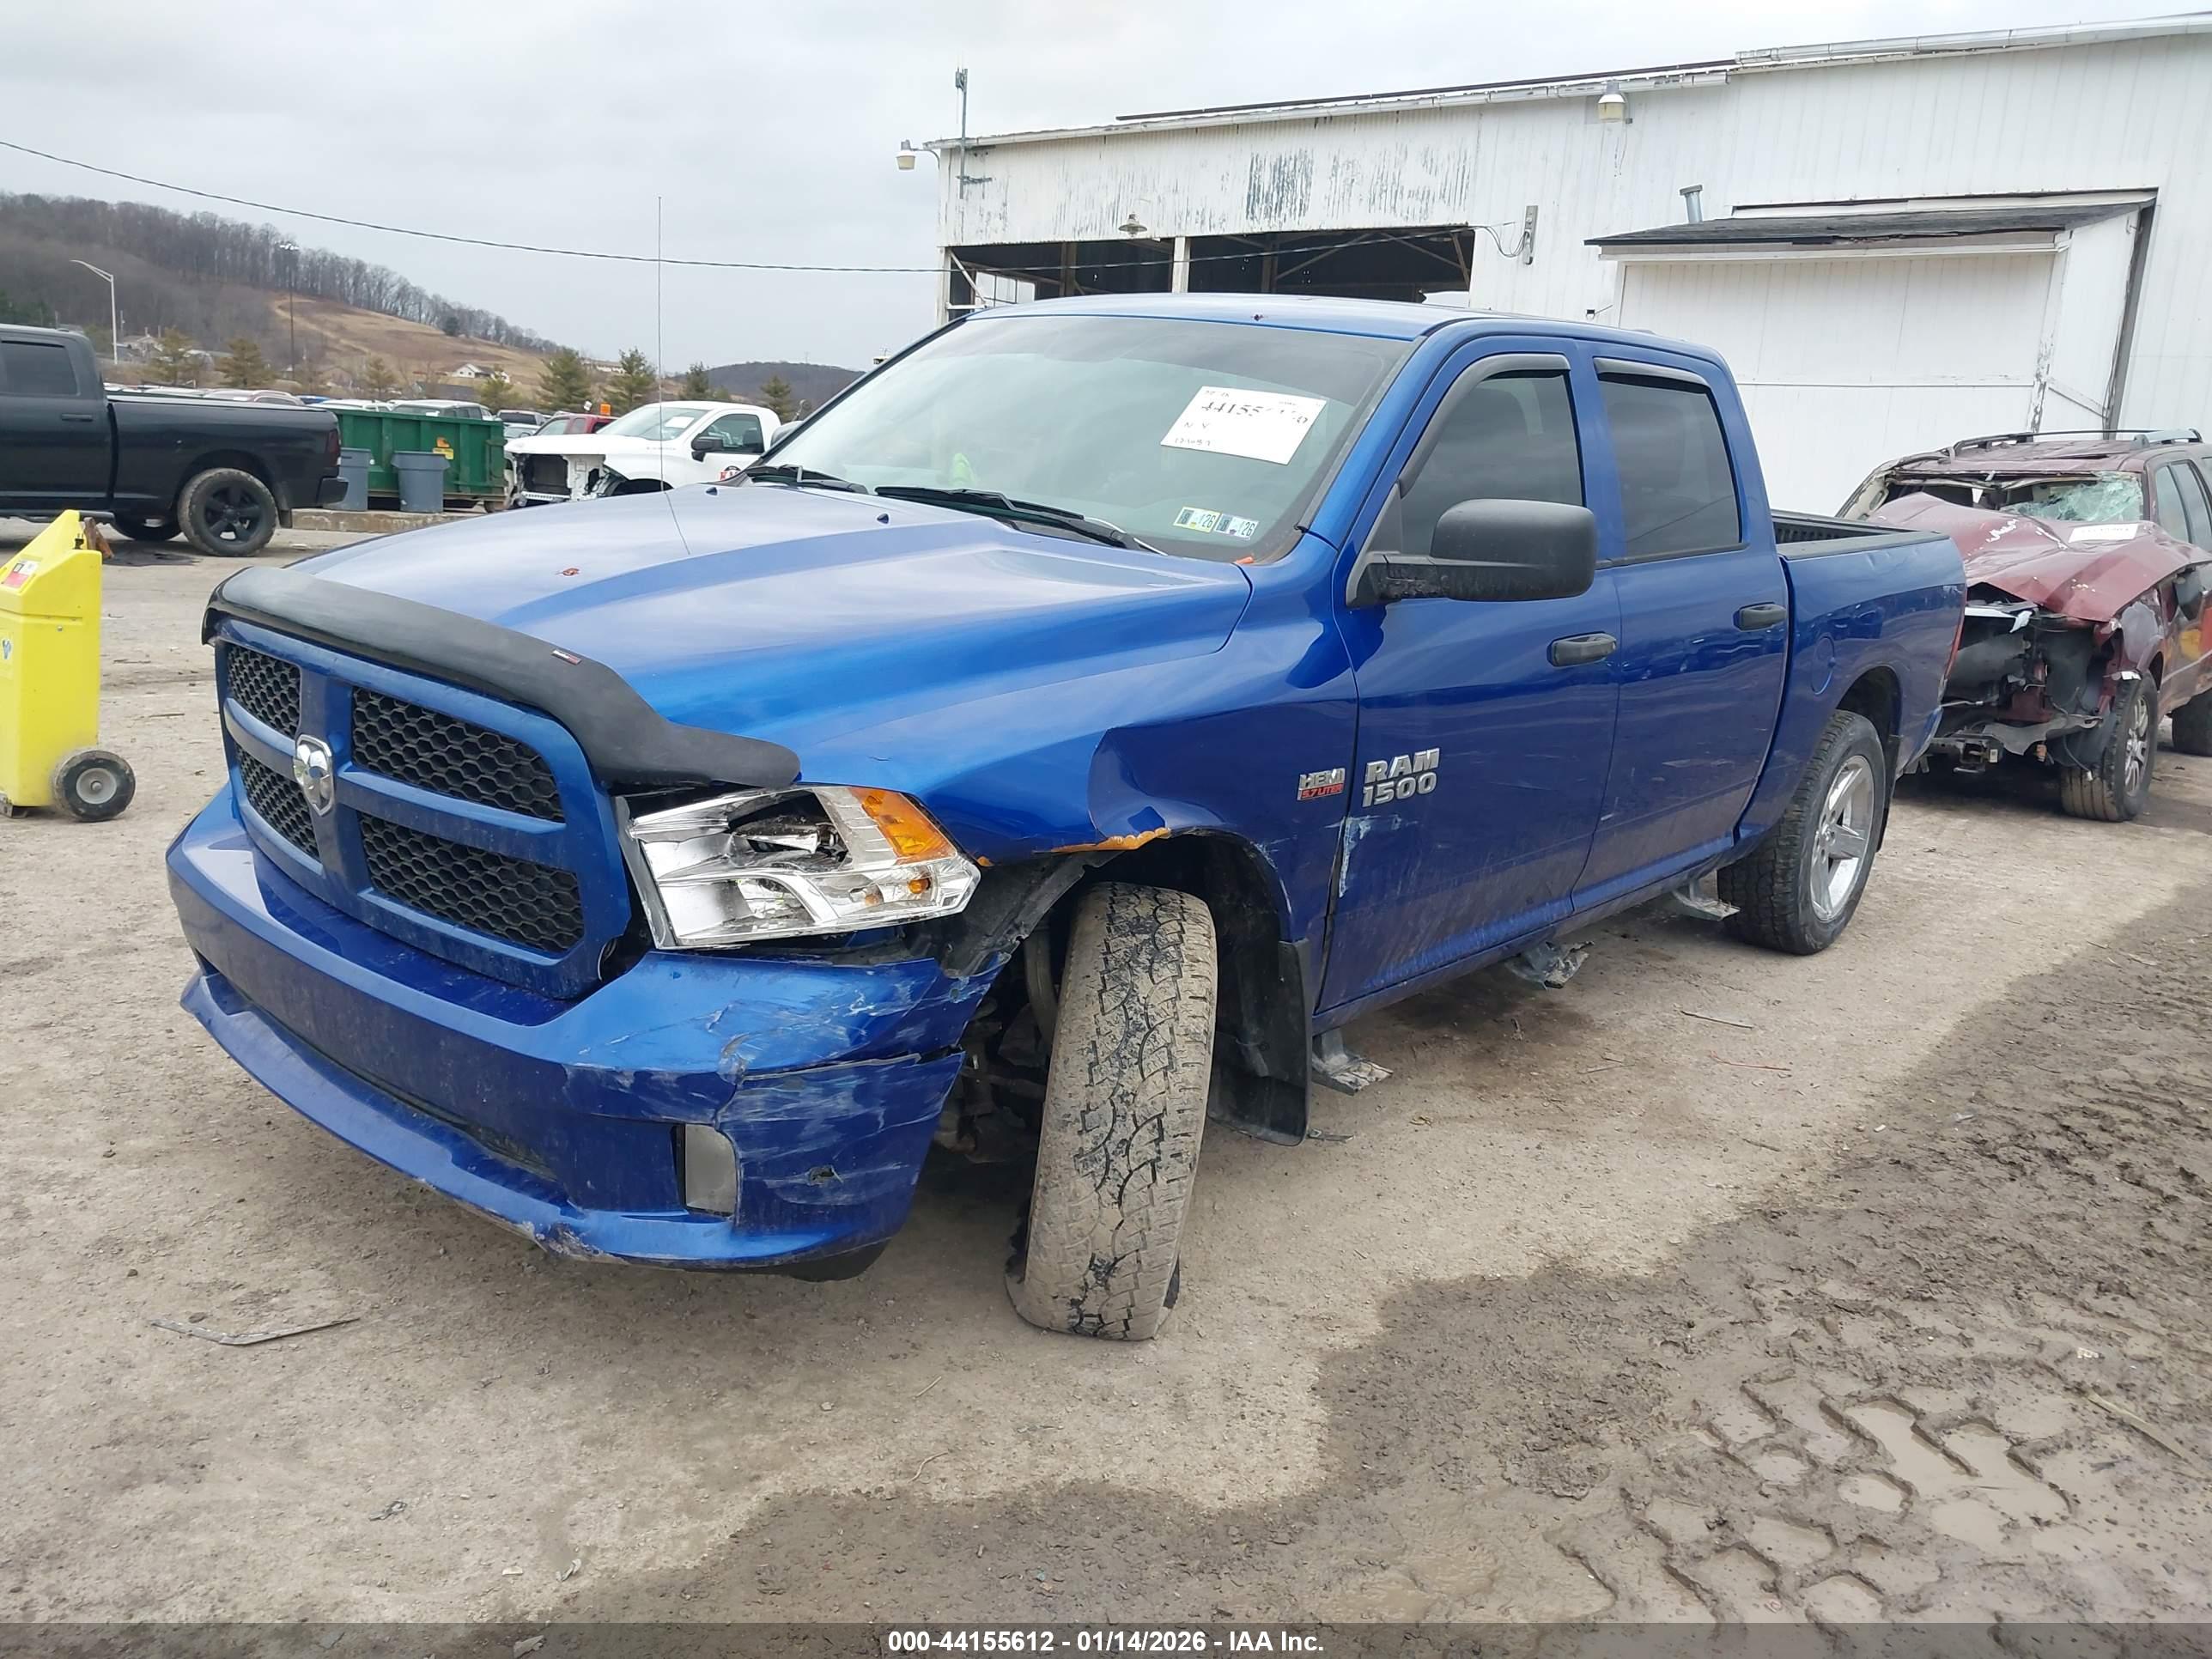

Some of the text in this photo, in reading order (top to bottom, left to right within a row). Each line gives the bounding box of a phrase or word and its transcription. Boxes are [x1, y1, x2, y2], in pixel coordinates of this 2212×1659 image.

[1298, 768, 1346, 789] HEMI
[1364, 747, 1440, 784] RAM
[1318, 782, 1343, 795] LITER
[1362, 772, 1437, 808] 1500
